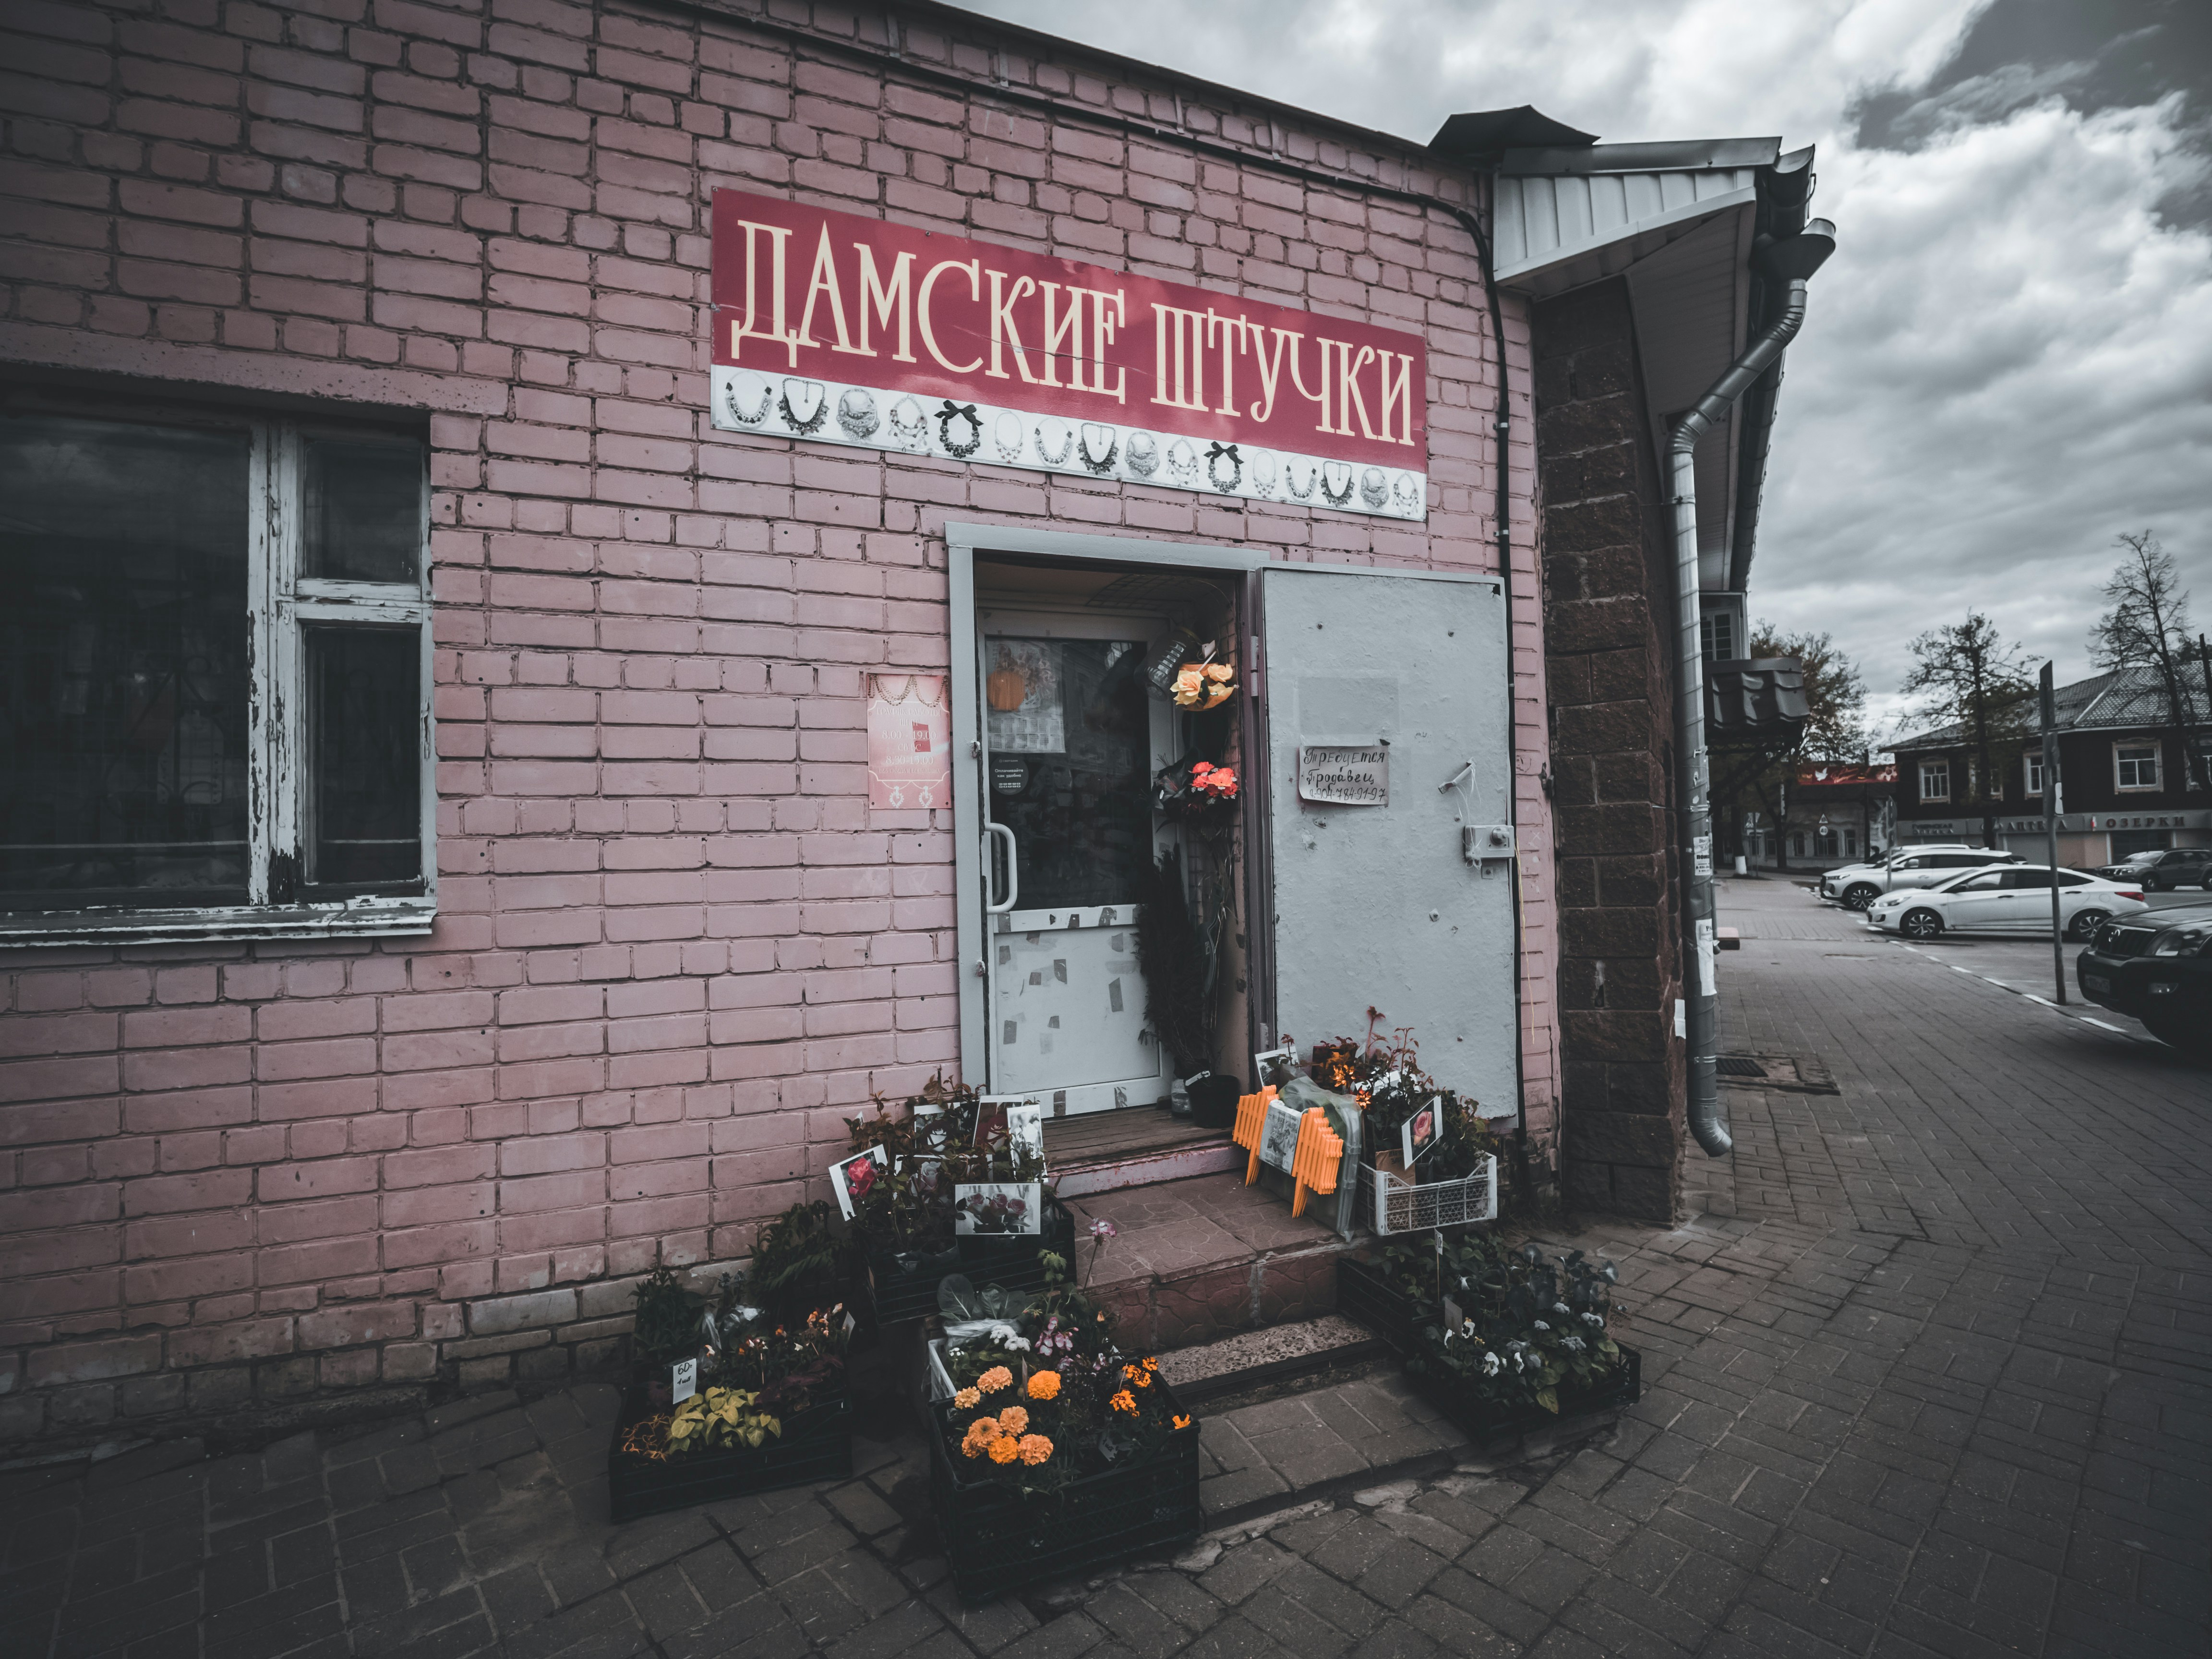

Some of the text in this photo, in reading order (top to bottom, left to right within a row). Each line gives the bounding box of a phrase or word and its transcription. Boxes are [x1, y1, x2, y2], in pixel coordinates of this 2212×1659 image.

[731, 219, 1415, 447] ДАМСКИЕ ШТУЧКИ
[882, 730, 902, 740] 8.00
[913, 730, 937, 740] 19.00
[1310, 787, 1386, 802] 8-904-784-91-97
[2007, 819, 2067, 831] АПТЕА
[2106, 816, 2184, 828] ОЗЕРКИ
